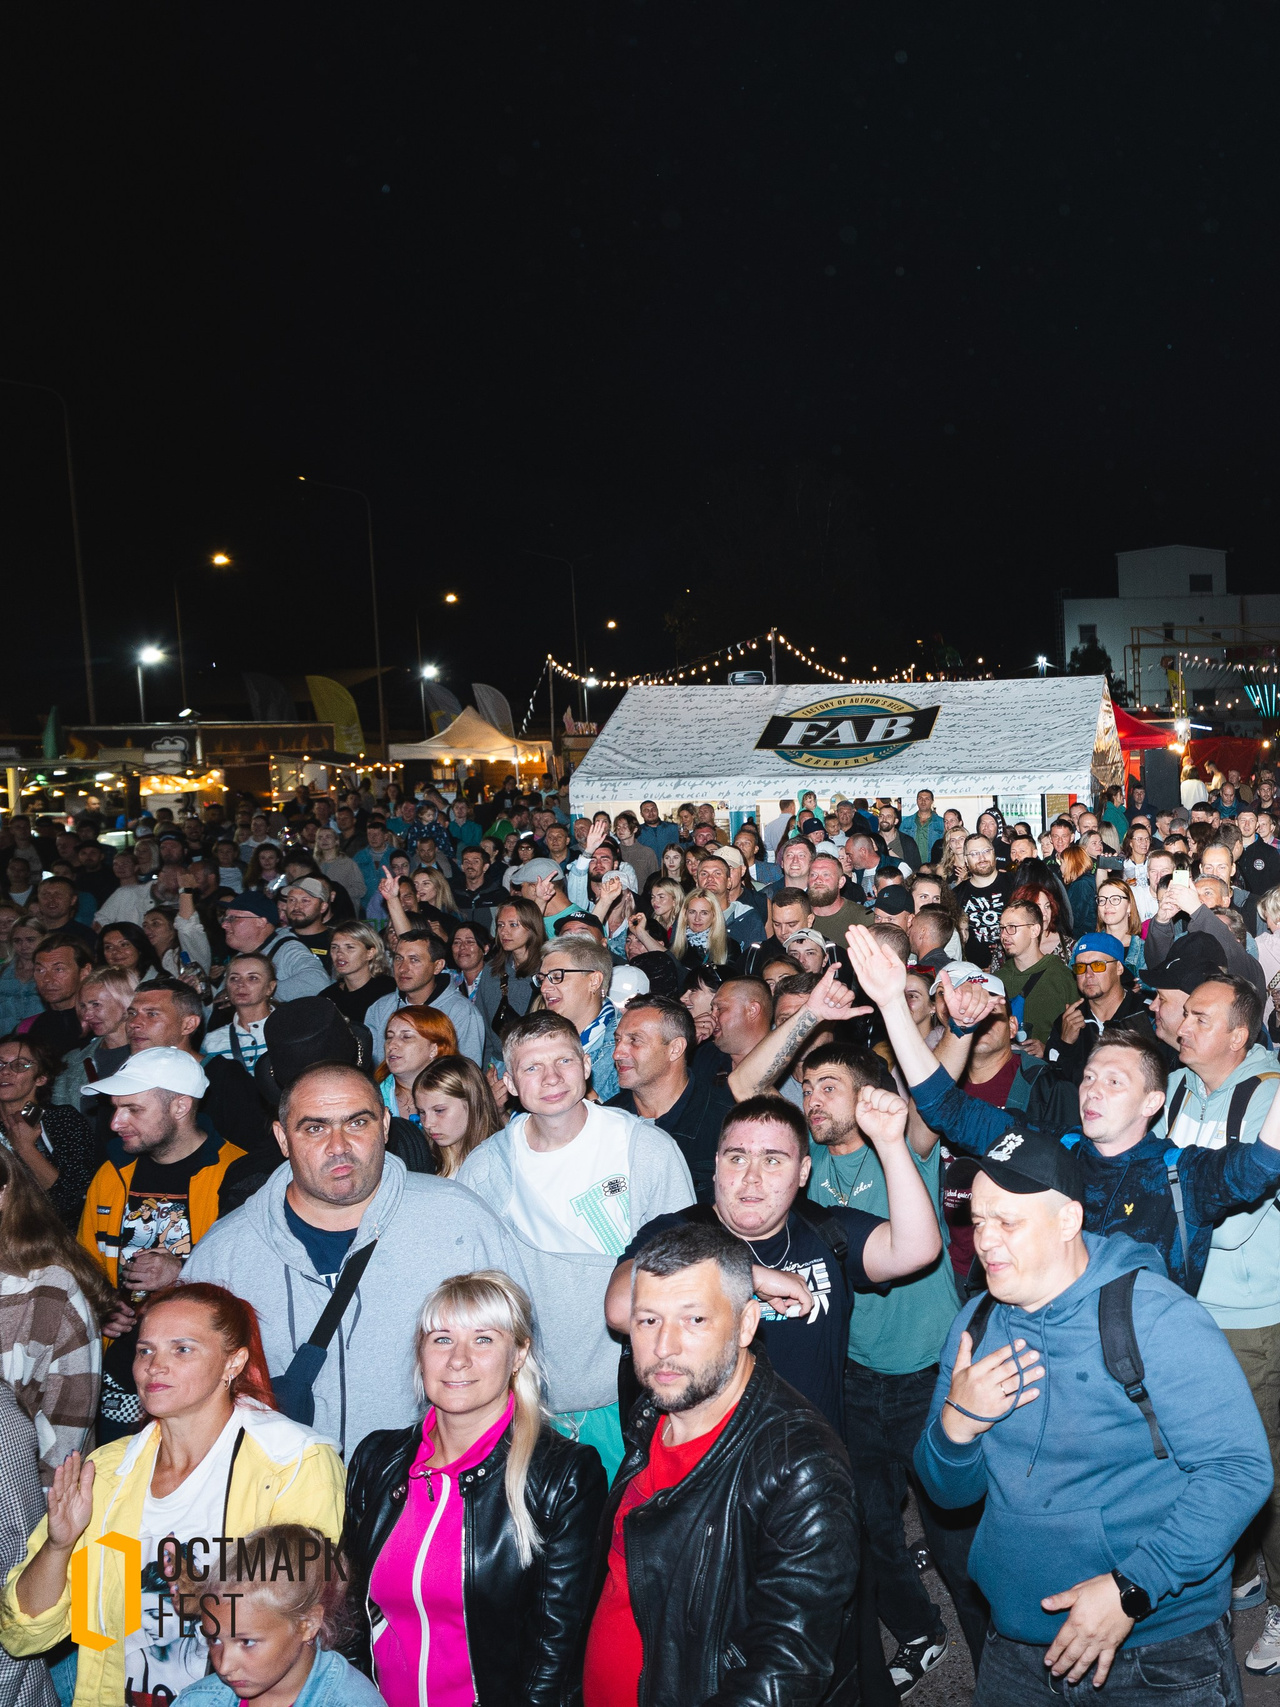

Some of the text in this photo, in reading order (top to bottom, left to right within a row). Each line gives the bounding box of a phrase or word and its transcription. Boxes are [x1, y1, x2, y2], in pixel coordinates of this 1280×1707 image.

[802, 702, 835, 717] FACTORY
[849, 698, 887, 706] AUTHOR'S
[887, 699, 905, 711] BEER
[778, 716, 916, 746] FAB
[804, 756, 870, 767] BREWERY
